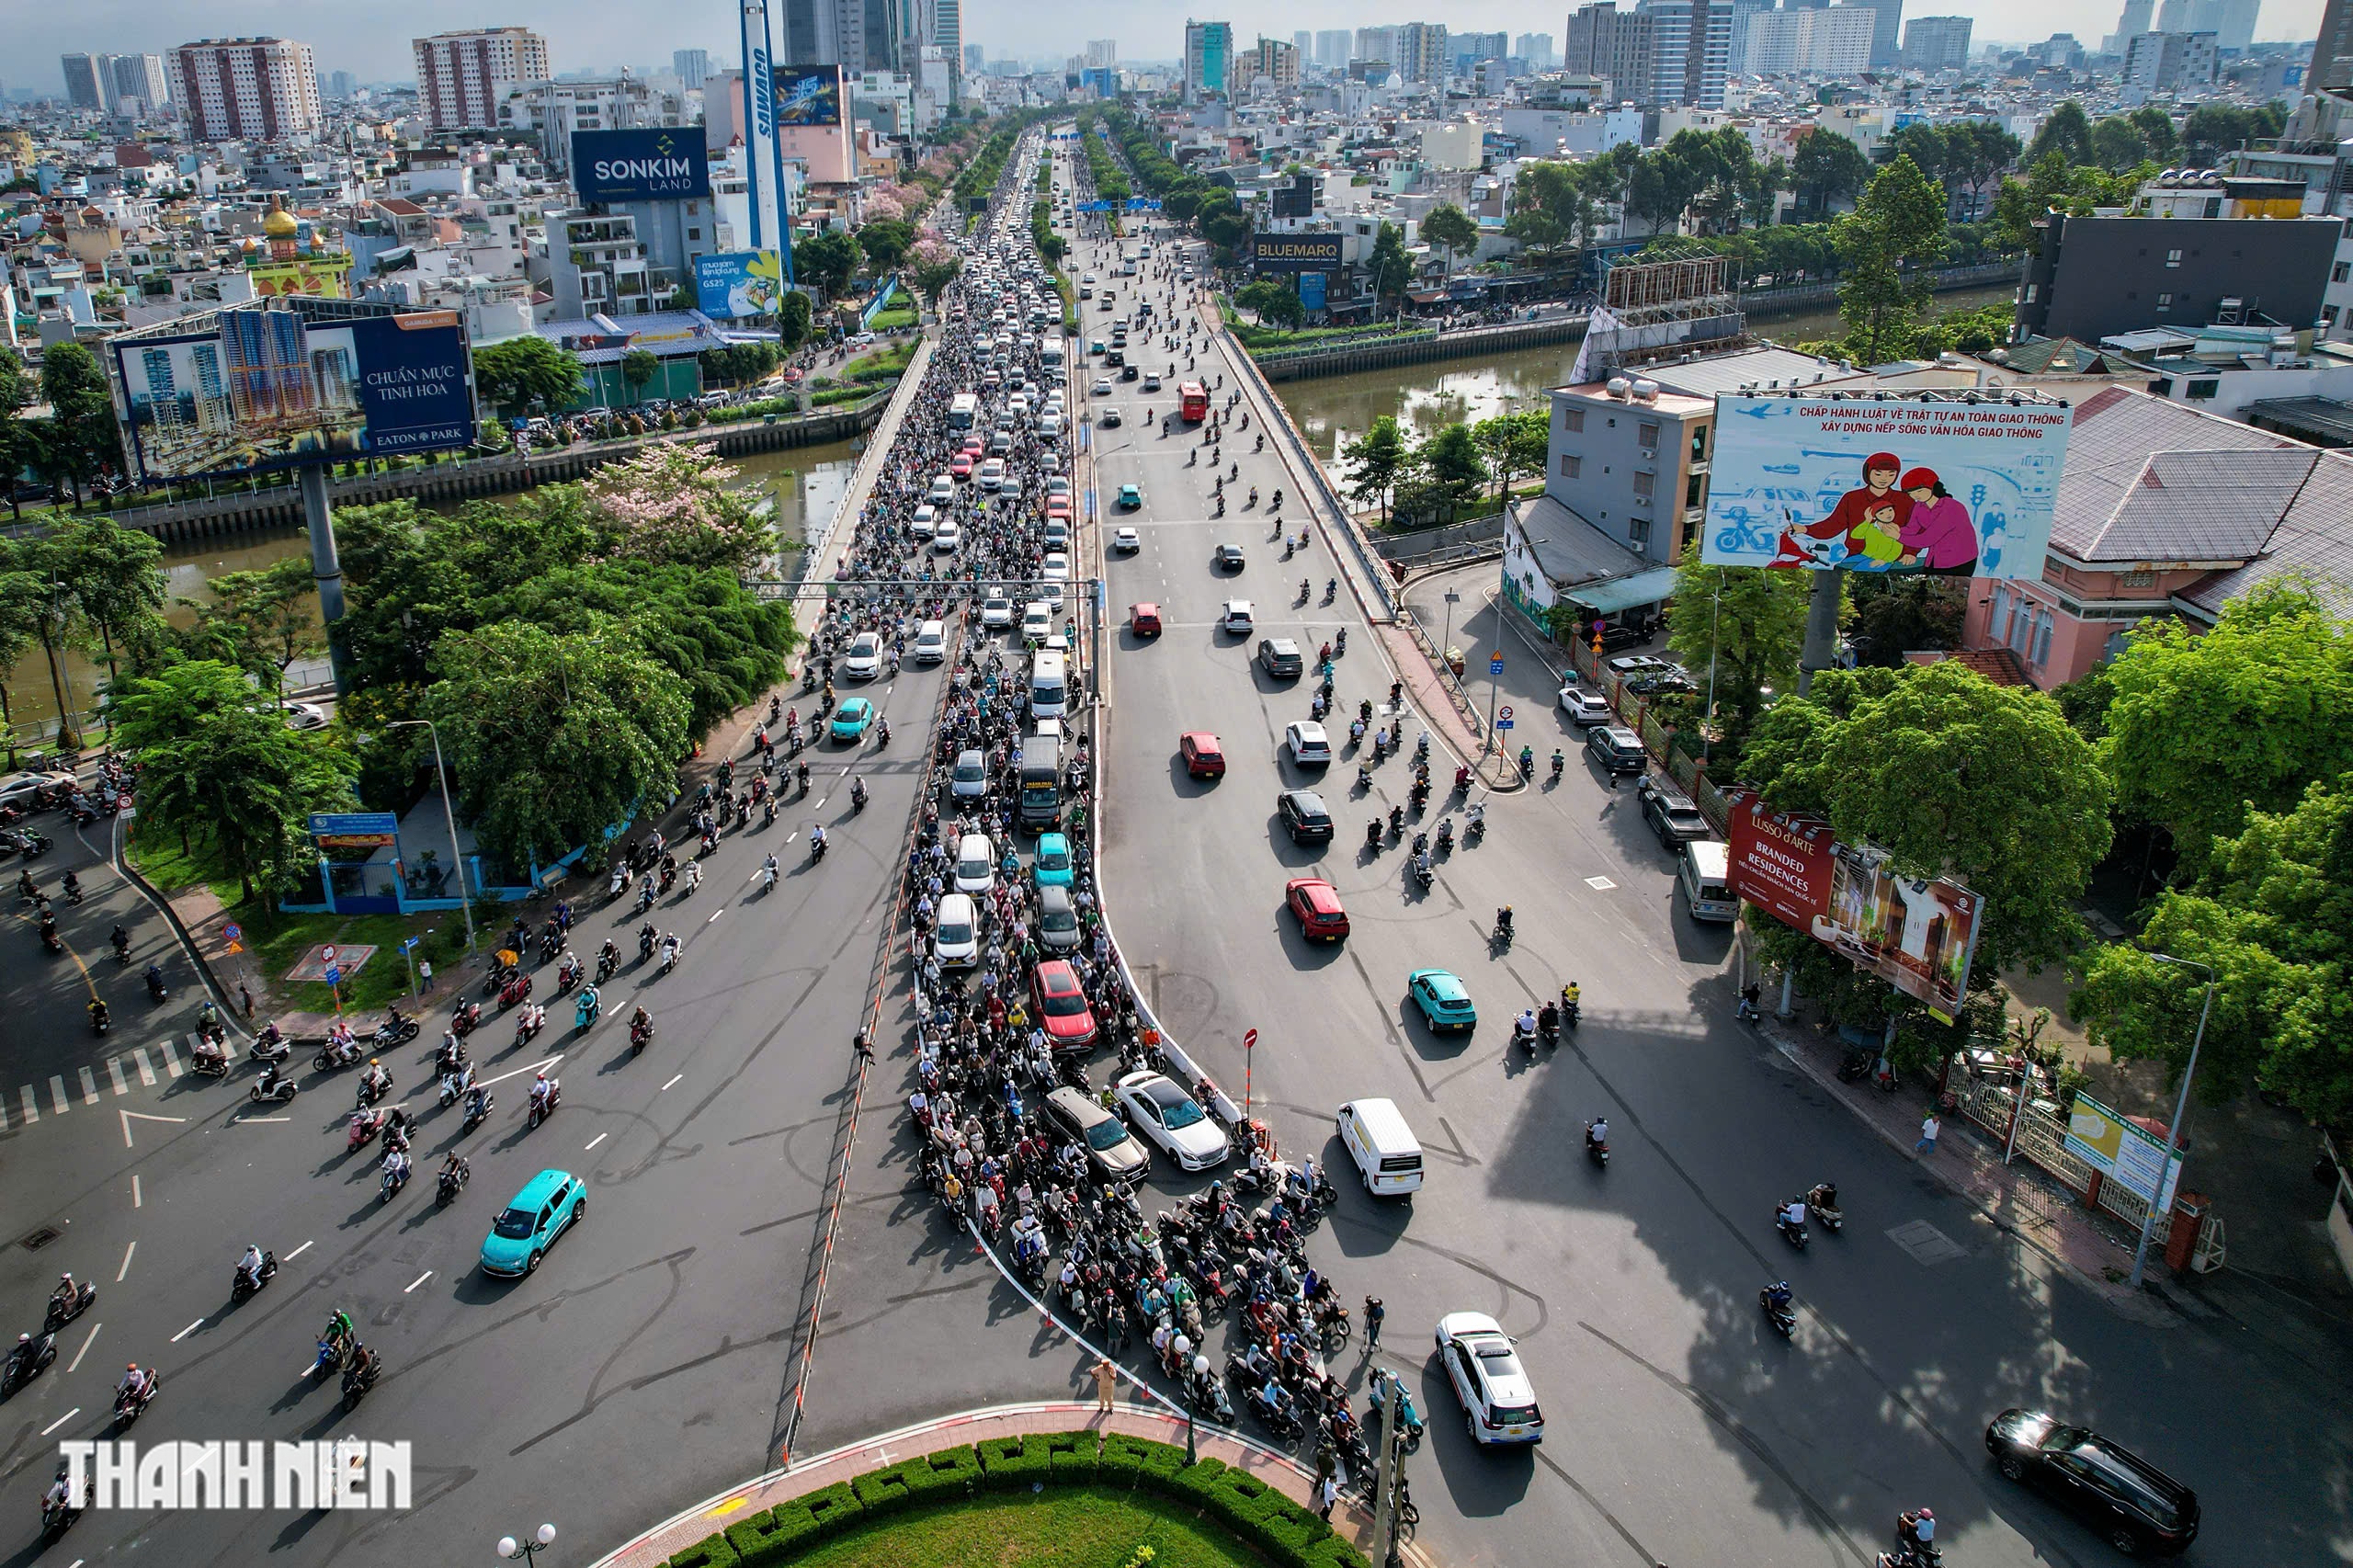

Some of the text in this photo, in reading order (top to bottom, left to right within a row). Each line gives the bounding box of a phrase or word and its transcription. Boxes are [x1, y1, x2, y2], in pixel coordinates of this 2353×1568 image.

[754, 48, 771, 139] SAWACO
[595, 157, 690, 179] SONKIM
[649, 178, 691, 191] LAND
[1258, 244, 1336, 256] BLUEMARQ
[703, 279, 724, 288] GS25
[368, 366, 454, 384] CHUẨN MỰC
[378, 383, 448, 401] TINH HOA
[1800, 405, 2064, 425] CHẤP HÀNH LUẬT VỀ TRẬT TỰ AN TOÀN GIAO THÔNG
[377, 428, 461, 446] EATON PARK
[1821, 421, 2042, 438] XÂY DỰNG NẾP SỐNG VĂN HÓA GIAO THÔNG
[1752, 816, 1815, 856] LUSSO d'ARTE
[1756, 841, 1804, 873] BRANDED
[1748, 853, 1809, 892] RESIDENCES
